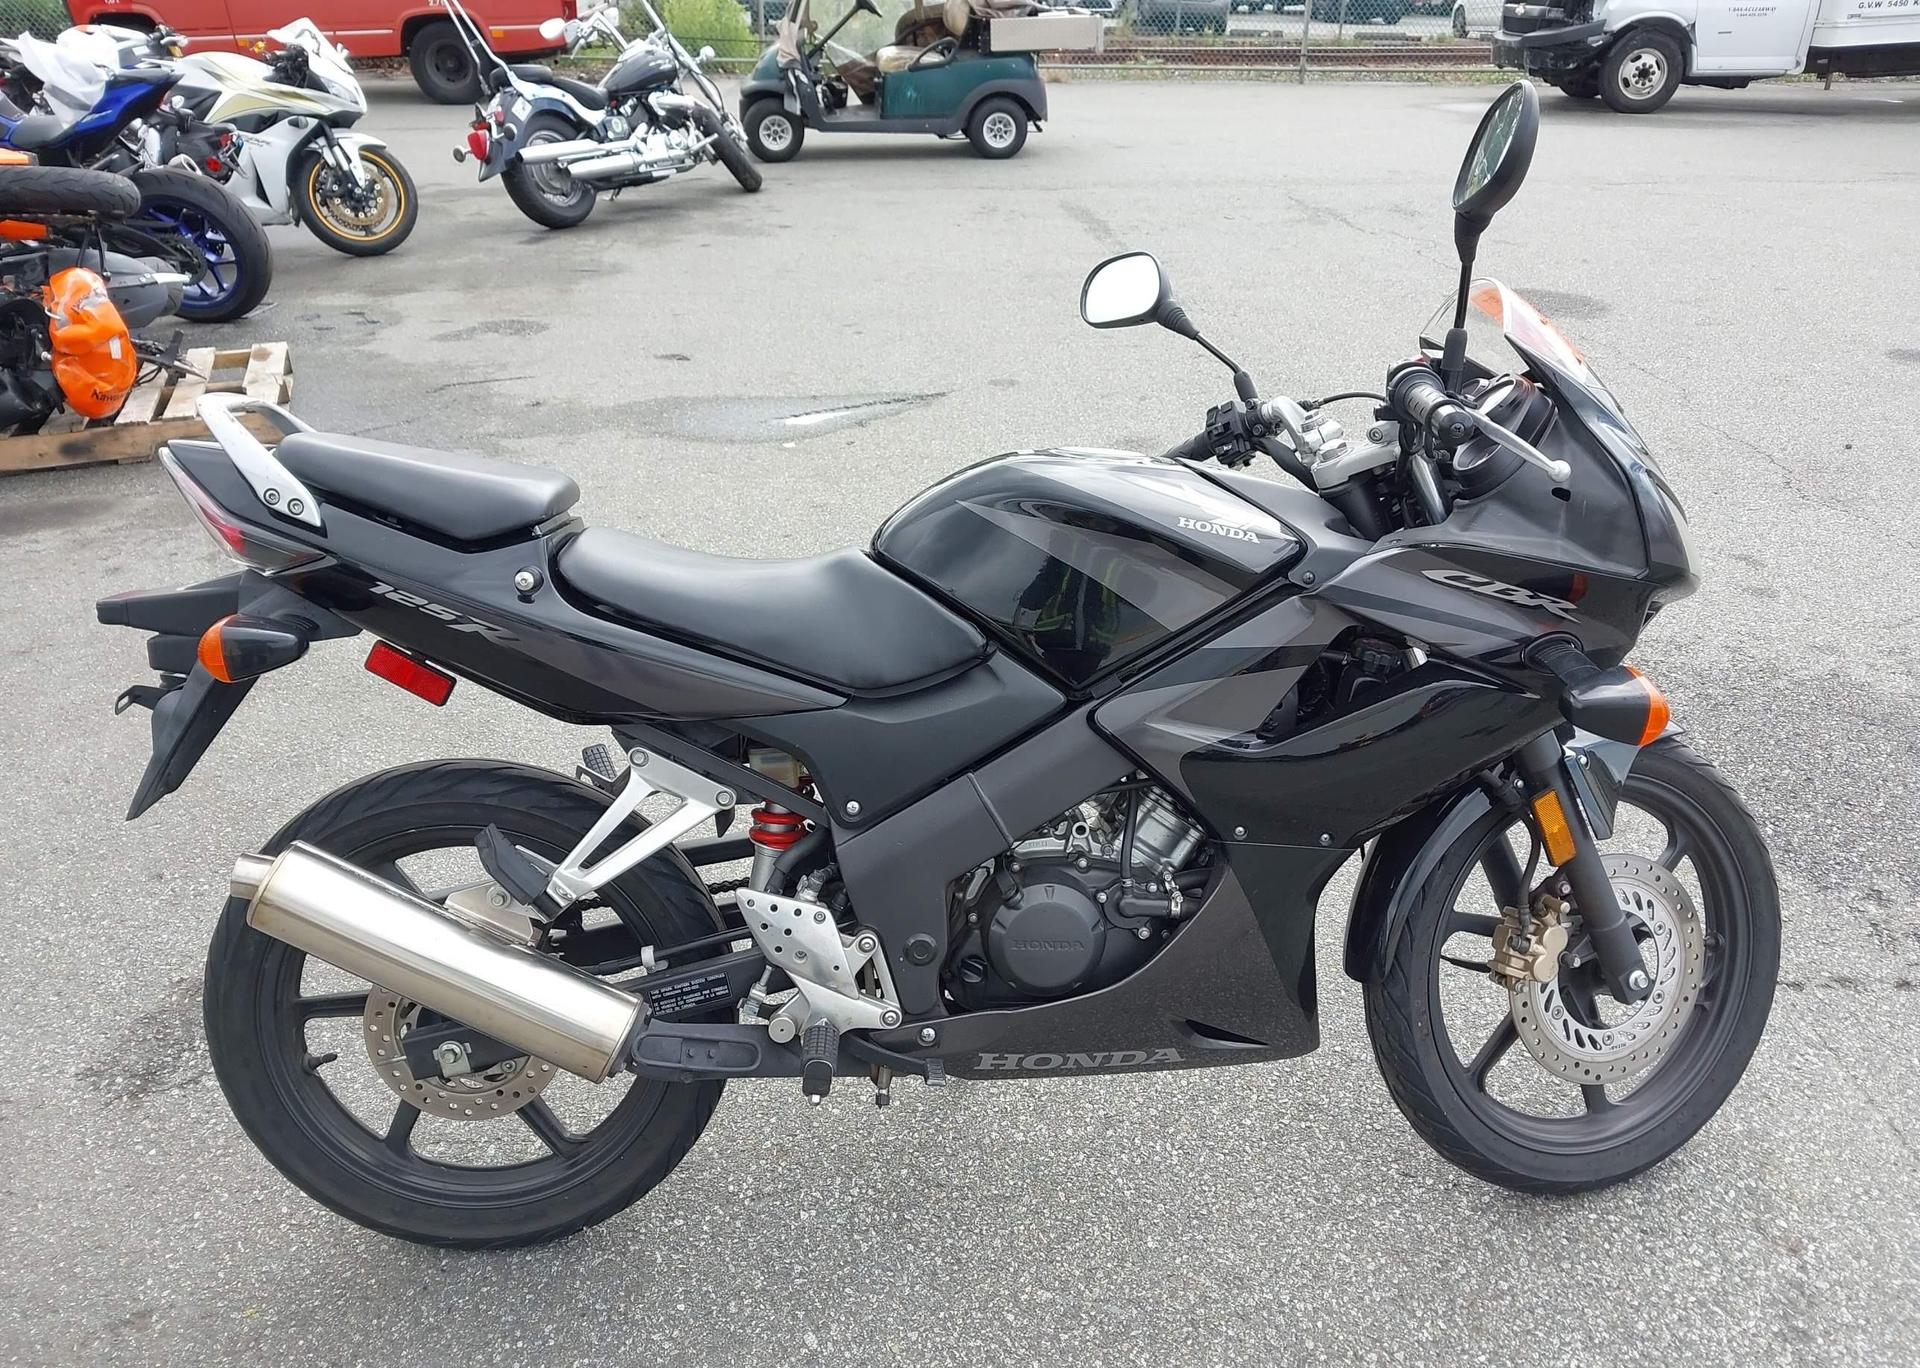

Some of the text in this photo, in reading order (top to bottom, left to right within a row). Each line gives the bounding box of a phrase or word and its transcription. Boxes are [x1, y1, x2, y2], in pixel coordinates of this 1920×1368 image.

[1177, 516, 1260, 543] HONDA
[1420, 569, 1582, 624] CBR
[1010, 939, 1085, 951] HONDA
[974, 1047, 1185, 1070] HONDA
